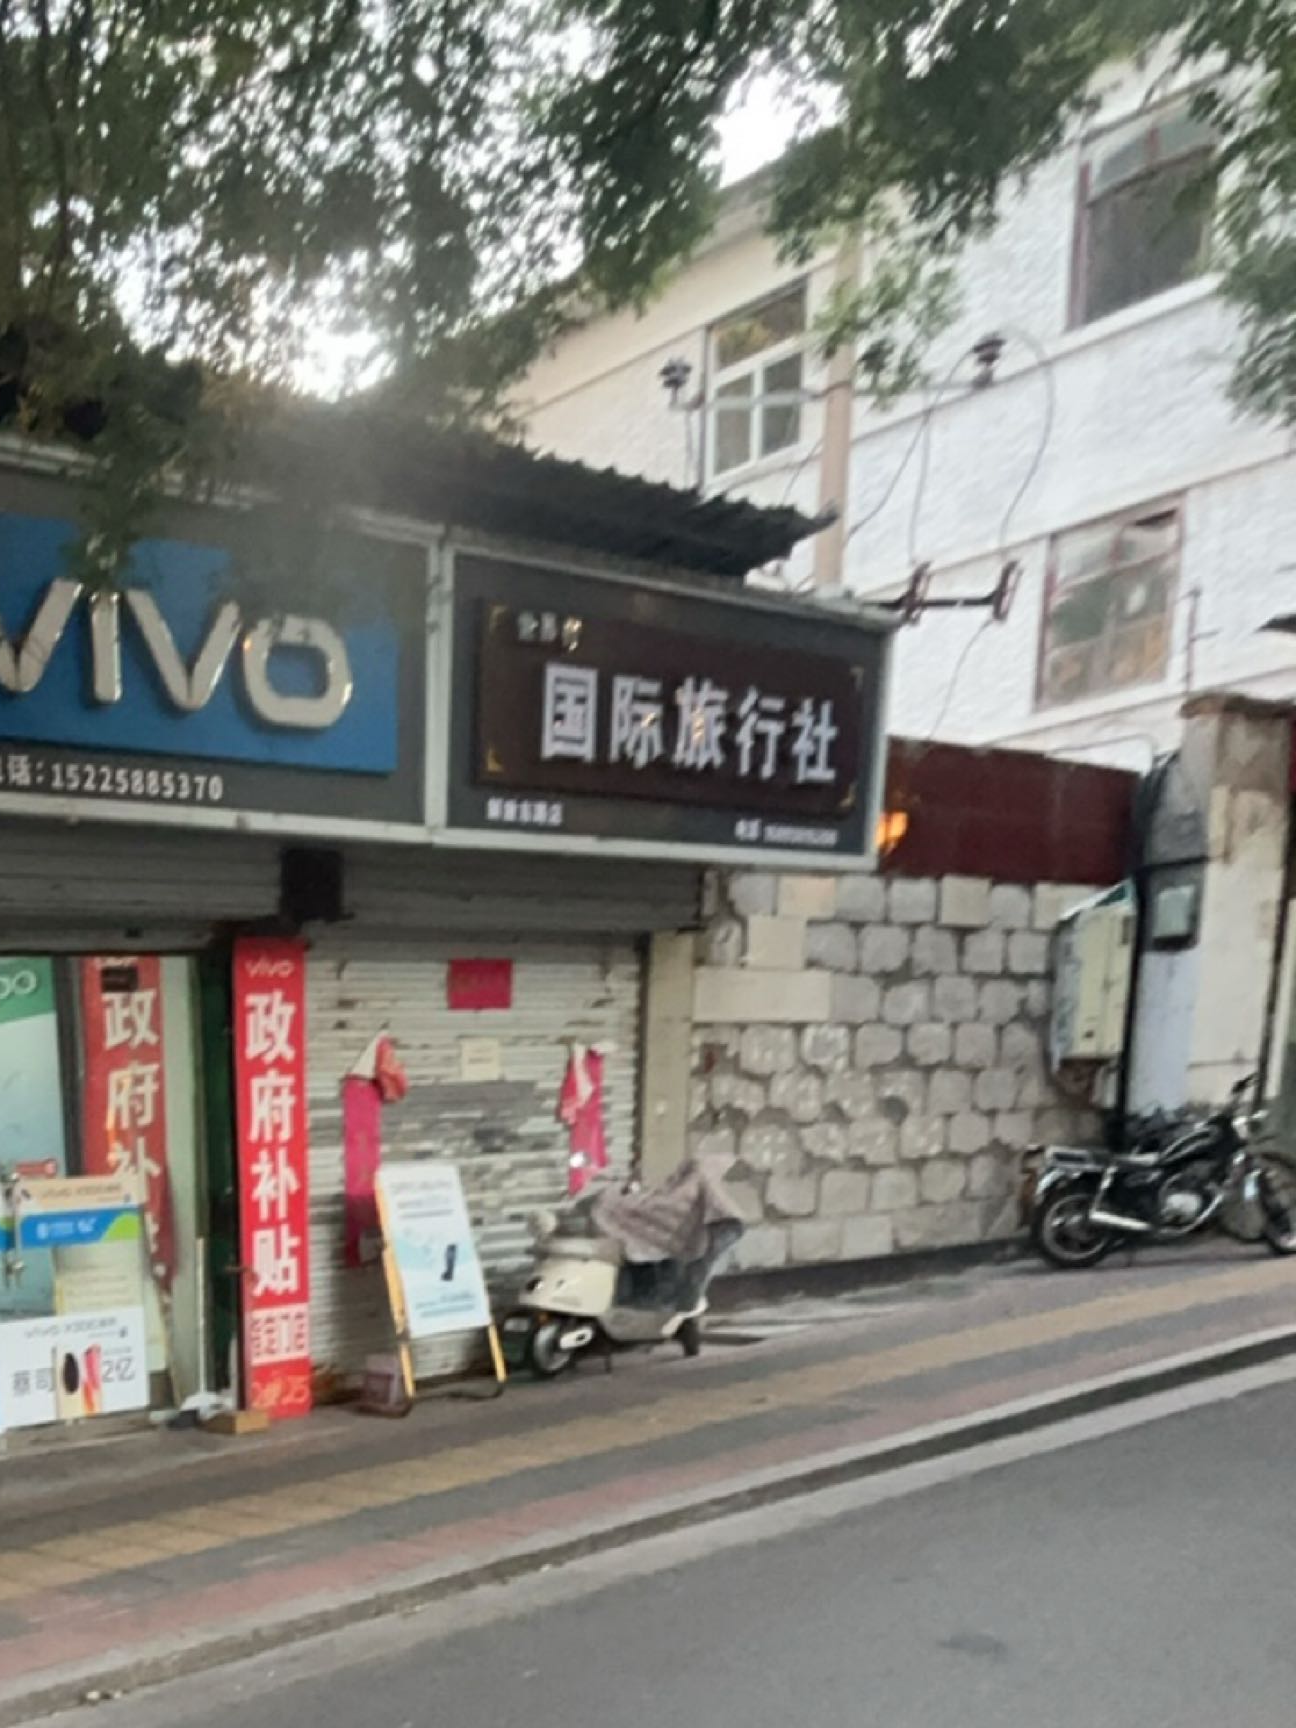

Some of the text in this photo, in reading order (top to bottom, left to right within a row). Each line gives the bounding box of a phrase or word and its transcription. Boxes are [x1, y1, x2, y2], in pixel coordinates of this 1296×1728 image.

[541, 661, 840, 784] 国际旅行社
[245, 957, 296, 979] vivo
[244, 987, 301, 1297] 政府补贴
